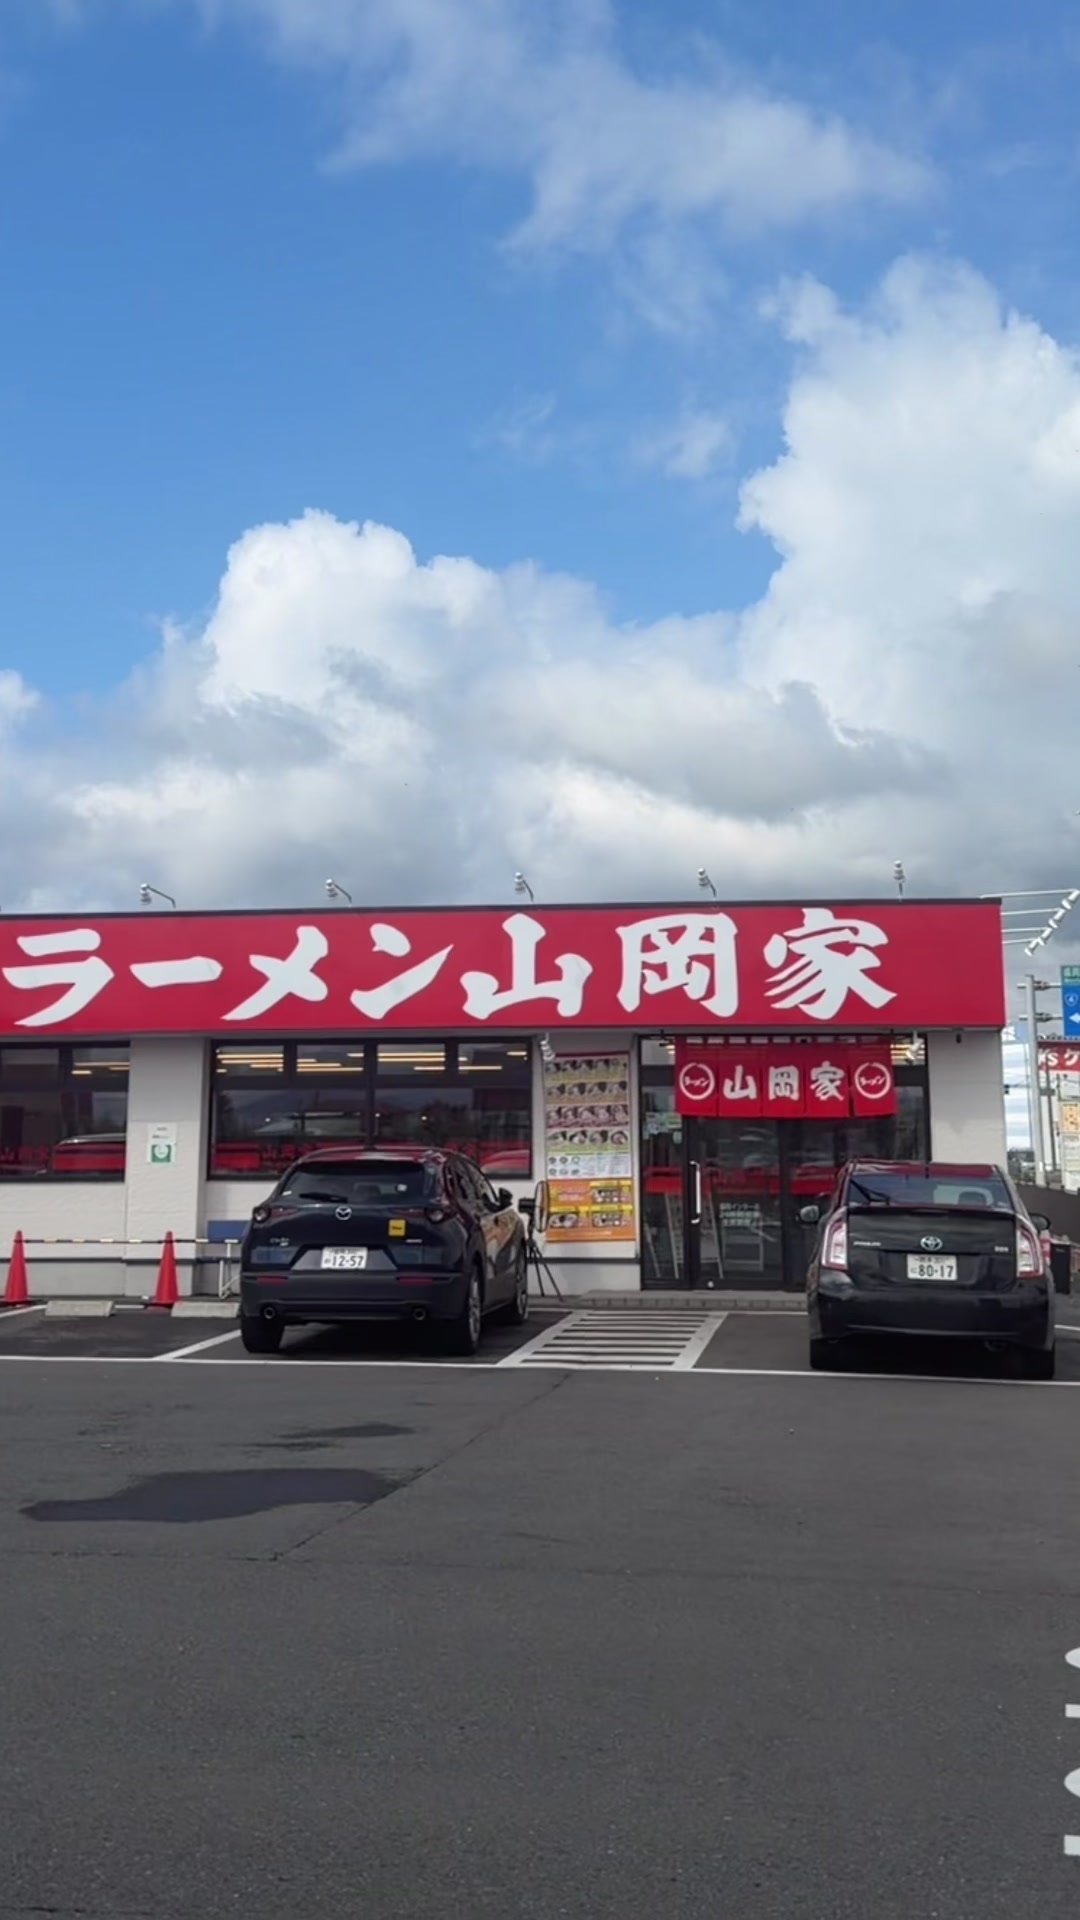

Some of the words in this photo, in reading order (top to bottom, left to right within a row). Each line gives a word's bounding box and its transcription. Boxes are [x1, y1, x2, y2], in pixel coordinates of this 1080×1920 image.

[2, 908, 897, 1023] ラーメン山岡家
[723, 1061, 846, 1101] 山岡家
[918, 1264, 954, 1278] 80-17
